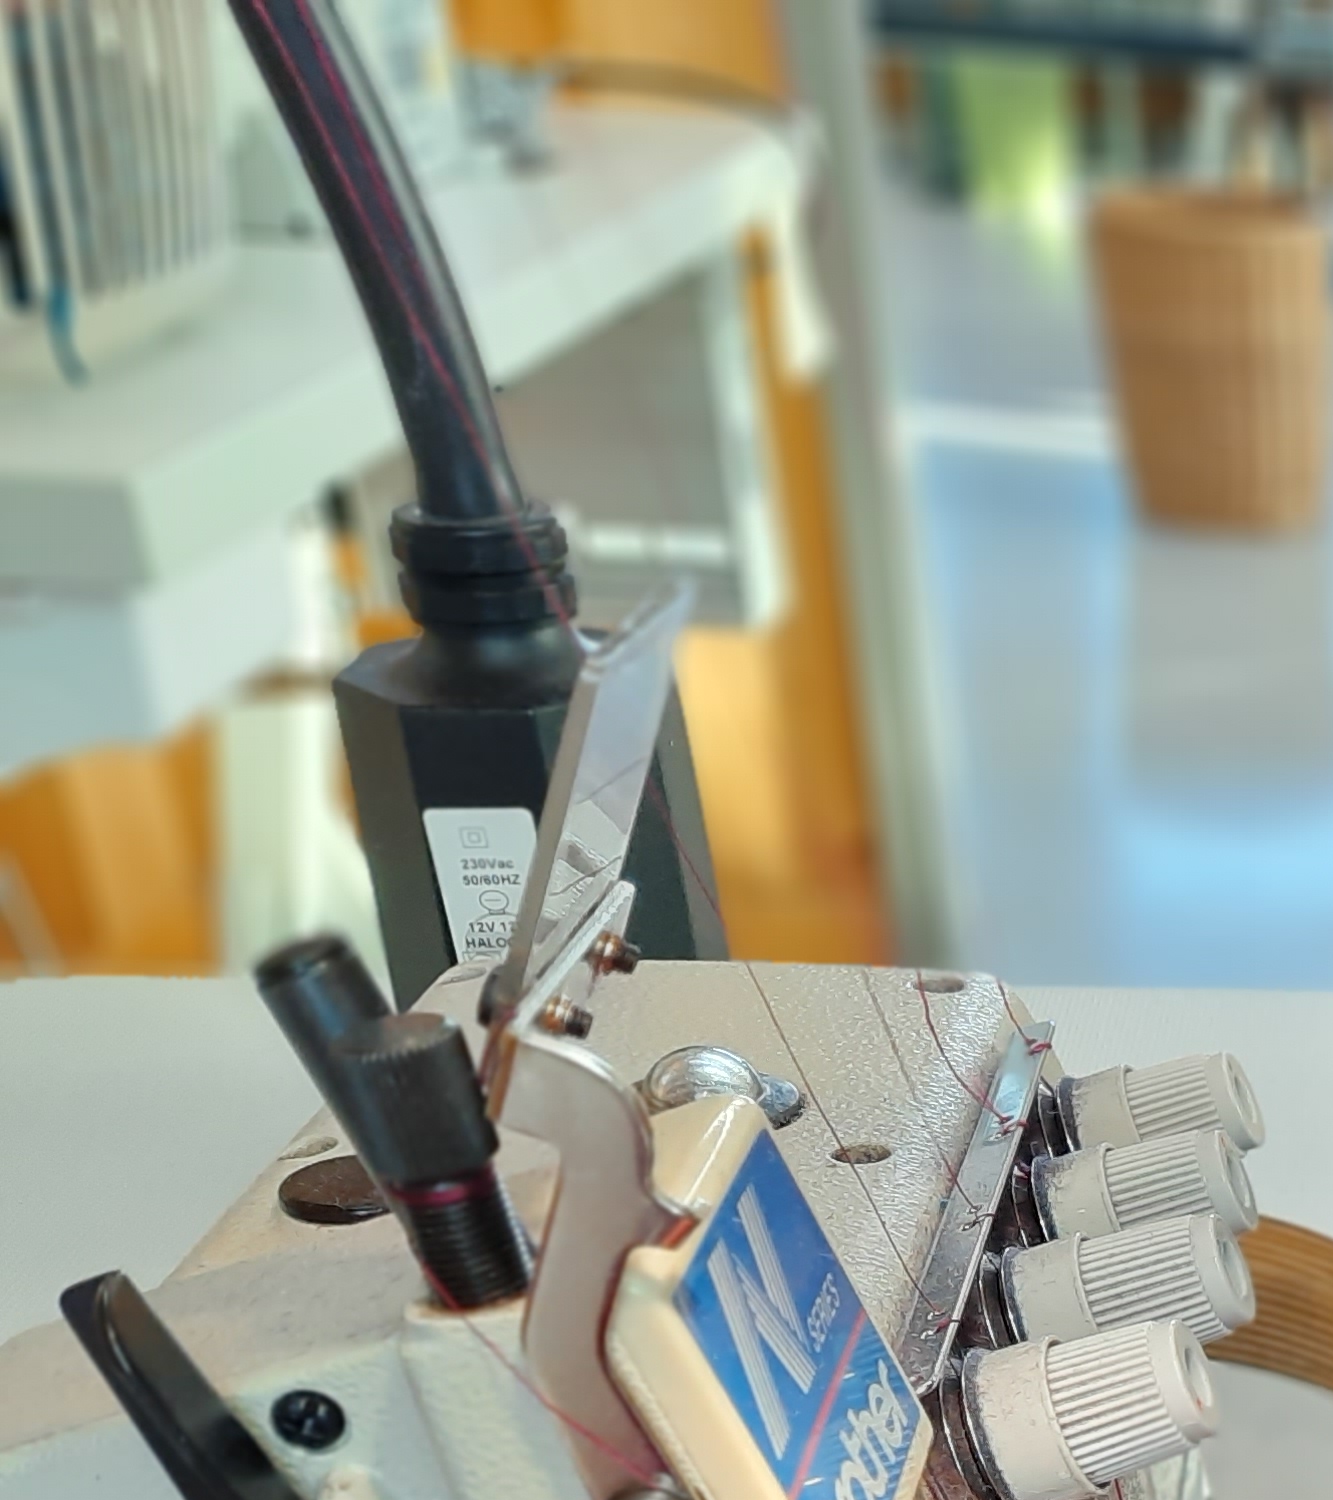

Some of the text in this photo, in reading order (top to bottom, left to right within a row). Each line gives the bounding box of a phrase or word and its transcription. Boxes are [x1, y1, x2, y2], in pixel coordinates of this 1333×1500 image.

[469, 921, 495, 933] 12V
[465, 937, 509, 949] HALO
[806, 1272, 840, 1354] SERIES
